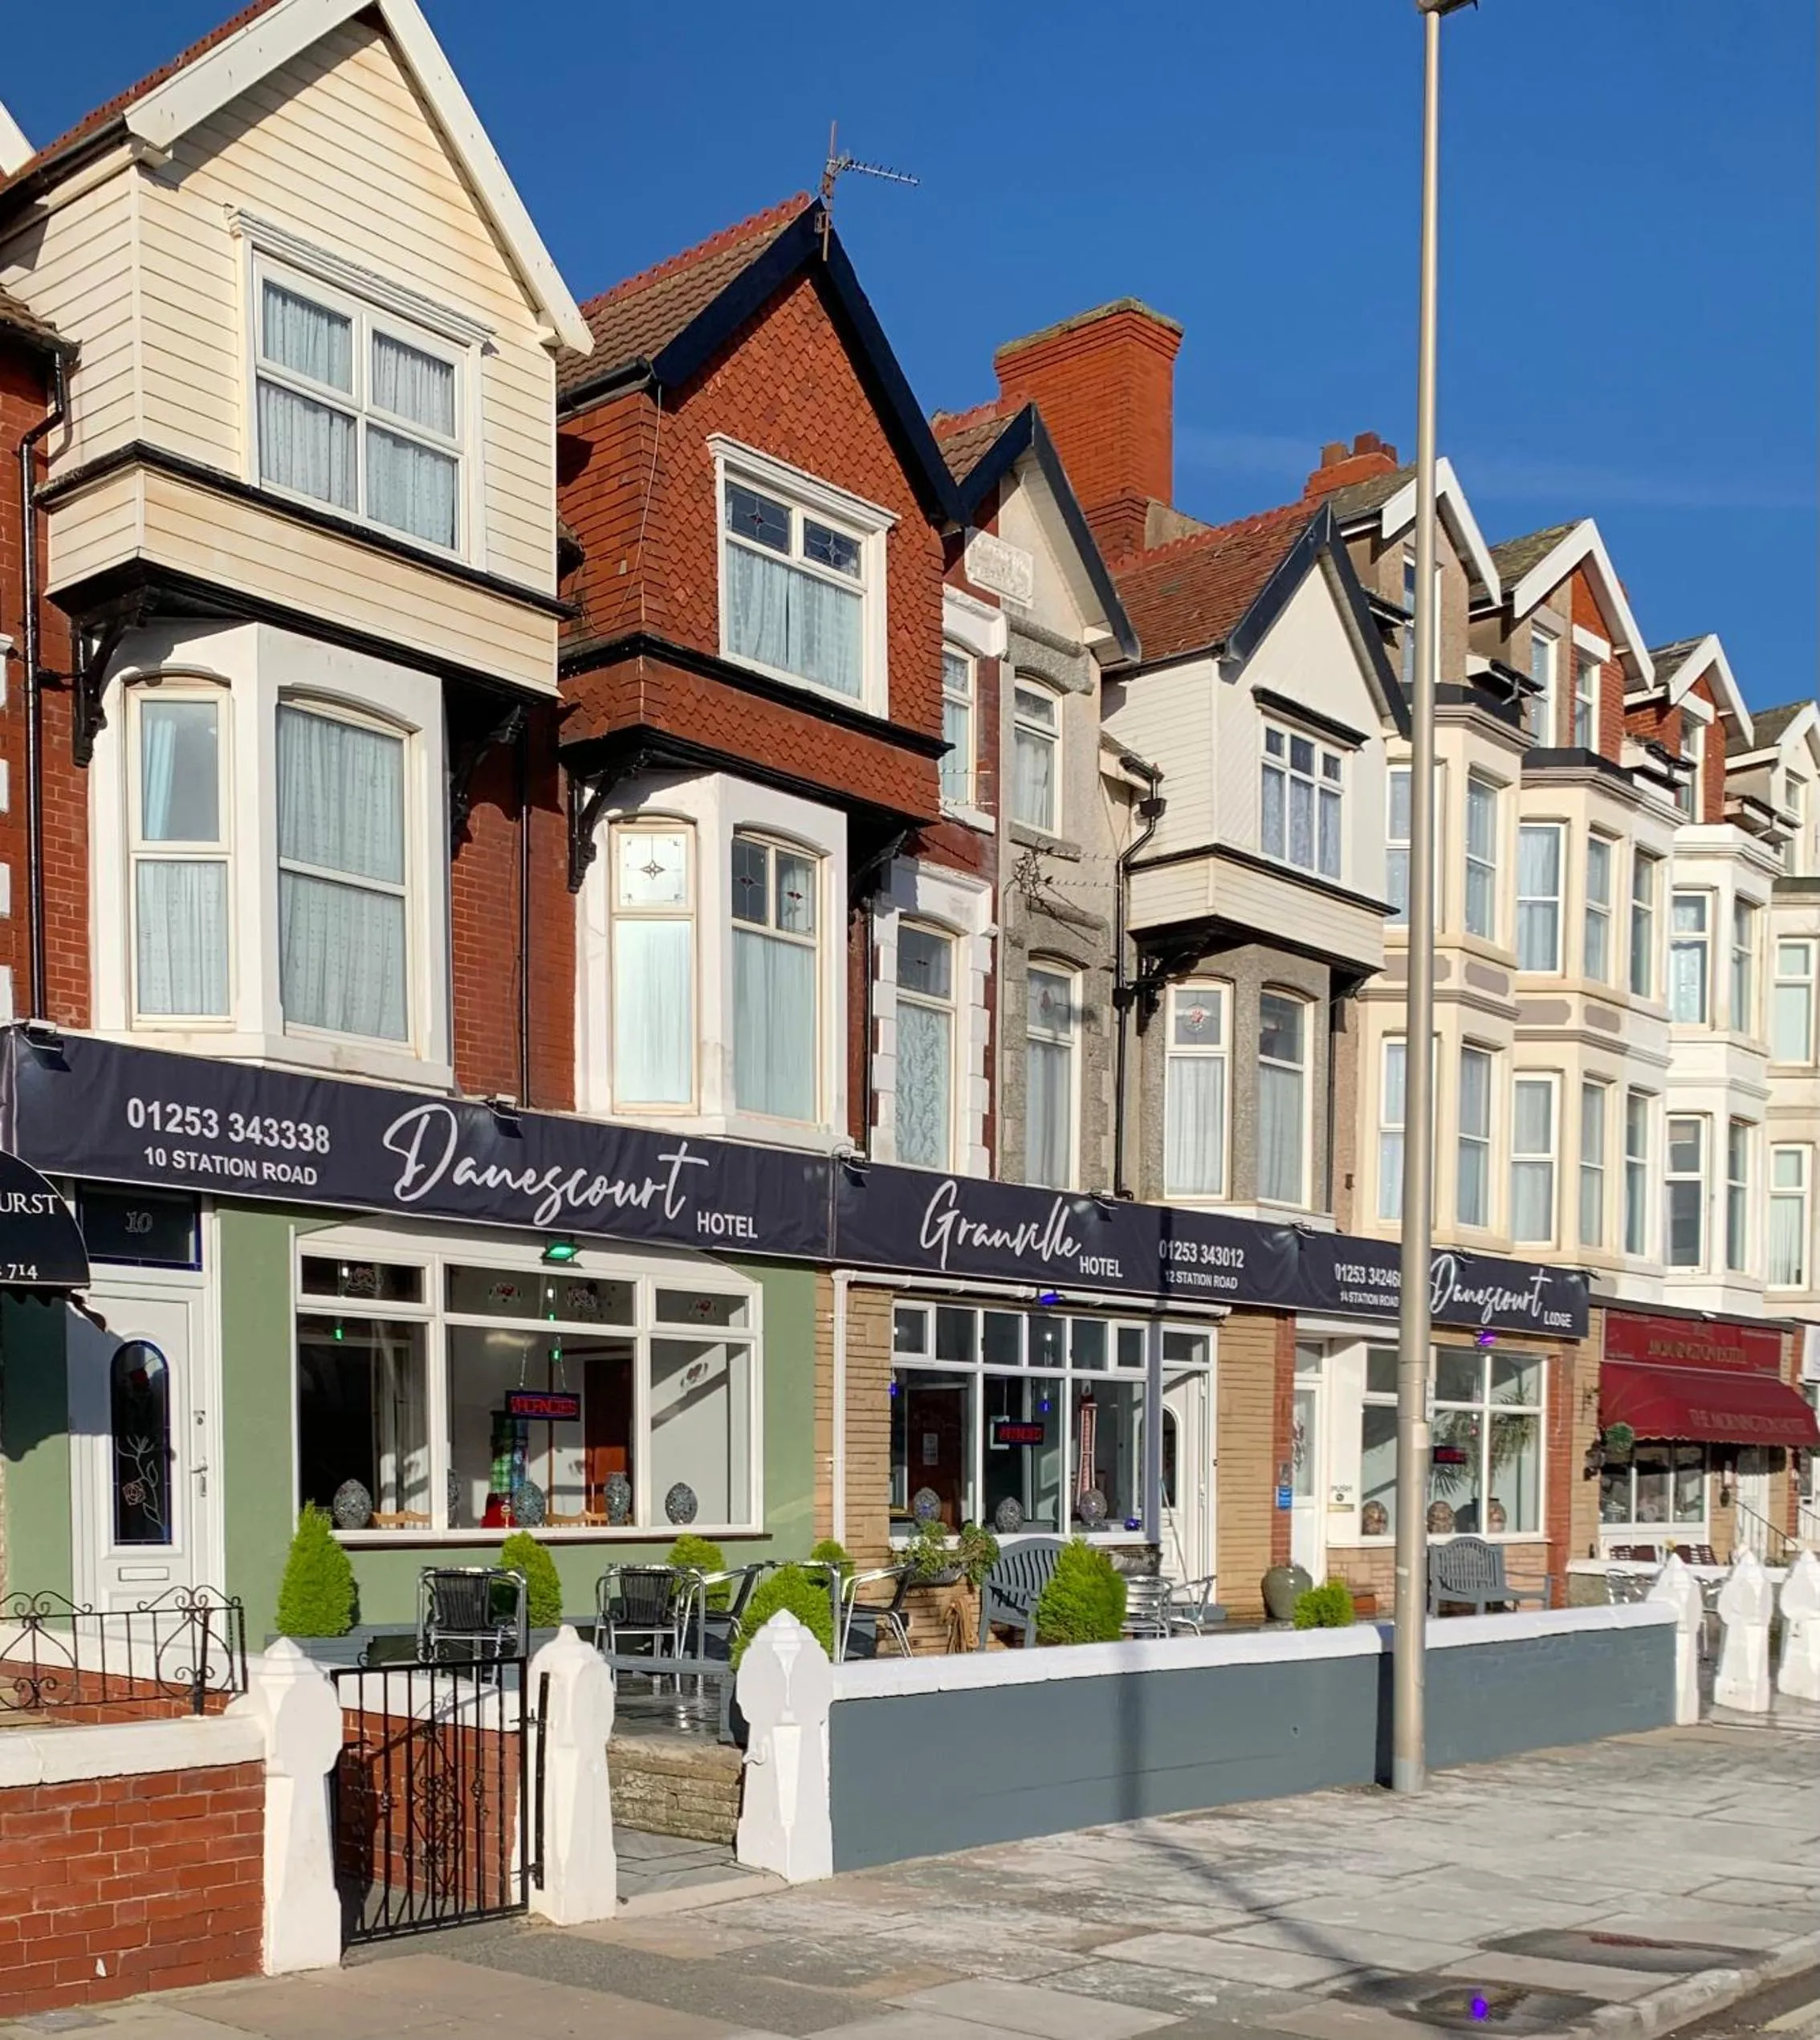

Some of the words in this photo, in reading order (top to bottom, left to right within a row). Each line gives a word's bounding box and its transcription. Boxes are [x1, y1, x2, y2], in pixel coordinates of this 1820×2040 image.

[127, 1097, 219, 1139] 01253
[228, 1112, 331, 1154] 343338
[144, 1146, 167, 1167] 10
[172, 1150, 257, 1180] STATION
[262, 1162, 319, 1186] ROAD
[382, 1103, 710, 1227] Danescourt
[124, 1210, 153, 1234] 10
[697, 1211, 759, 1240] HOTEL
[920, 1179, 1081, 1270] Granville
[1079, 1255, 1122, 1278] HOTEL
[1158, 1239, 1198, 1263] 01253
[1199, 1244, 1244, 1268] 343012
[7, 1264, 39, 1281] 714
[1165, 1270, 1175, 1284] 12
[1175, 1270, 1212, 1287] STATION
[1213, 1274, 1239, 1290] ROAD
[1334, 1262, 1366, 1285] 01253
[1349, 1291, 1378, 1305] STATION
[1430, 1253, 1553, 1325] Danescourt
[1543, 1310, 1574, 1328] LODGE
